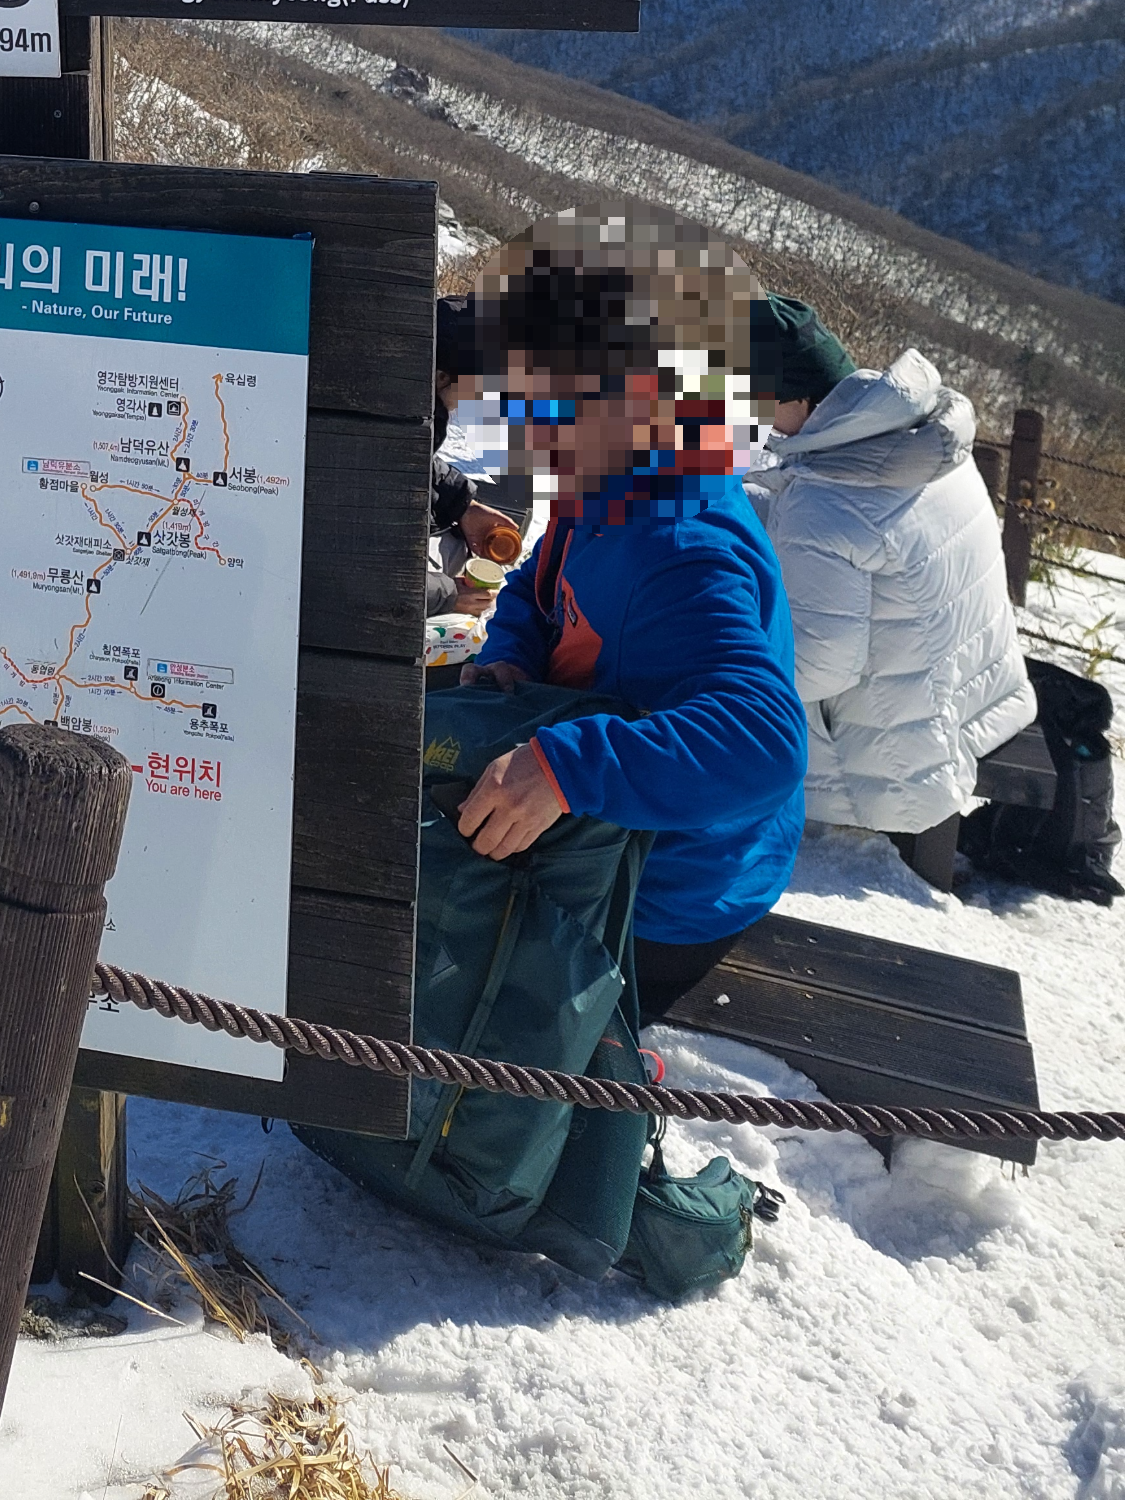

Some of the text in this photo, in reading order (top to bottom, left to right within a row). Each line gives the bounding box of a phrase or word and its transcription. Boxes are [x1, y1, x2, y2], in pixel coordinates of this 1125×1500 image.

[85, 248, 188, 304] 미래!
[31, 299, 173, 325] Nature, Our Future
[97, 370, 179, 393] 영각탐방지원센터
[225, 373, 257, 387] 육십령
[116, 397, 147, 414] 영각사
[120, 437, 169, 457] 남덕유산
[229, 466, 257, 484] 서봉
[39, 477, 79, 493] 황점마을
[55, 533, 113, 550] 삿갓재대피소
[153, 529, 191, 548] 삿갓봉
[47, 567, 84, 585] 무룡산
[60, 715, 92, 733] 백암봉
[190, 718, 229, 734] 용추폭포
[148, 752, 222, 787] 현위치
[145, 778, 222, 801] You are here
